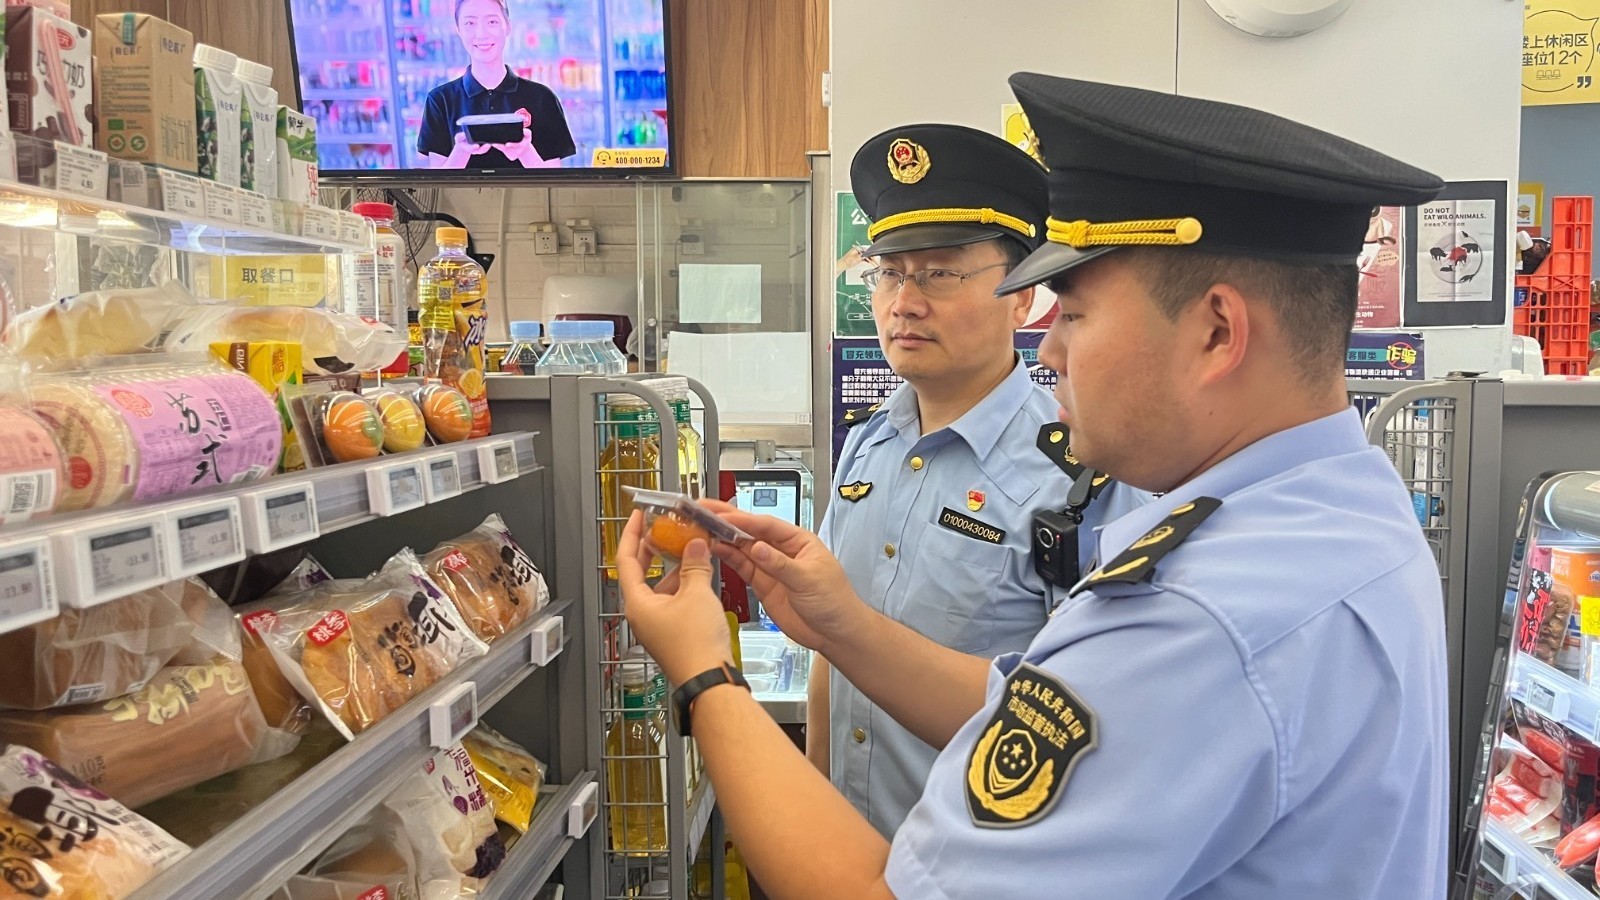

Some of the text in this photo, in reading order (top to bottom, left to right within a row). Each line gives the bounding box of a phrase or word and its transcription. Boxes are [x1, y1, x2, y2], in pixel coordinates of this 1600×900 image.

[1522, 50, 1583, 66] 座位12个
[242, 267, 294, 284] 取餐口
[1386, 345, 1417, 365] 诈骗
[943, 513, 1001, 542] 01000430084
[1010, 679, 1086, 740] 中华人民共和国
[1007, 695, 1070, 750] 市场监督执法
